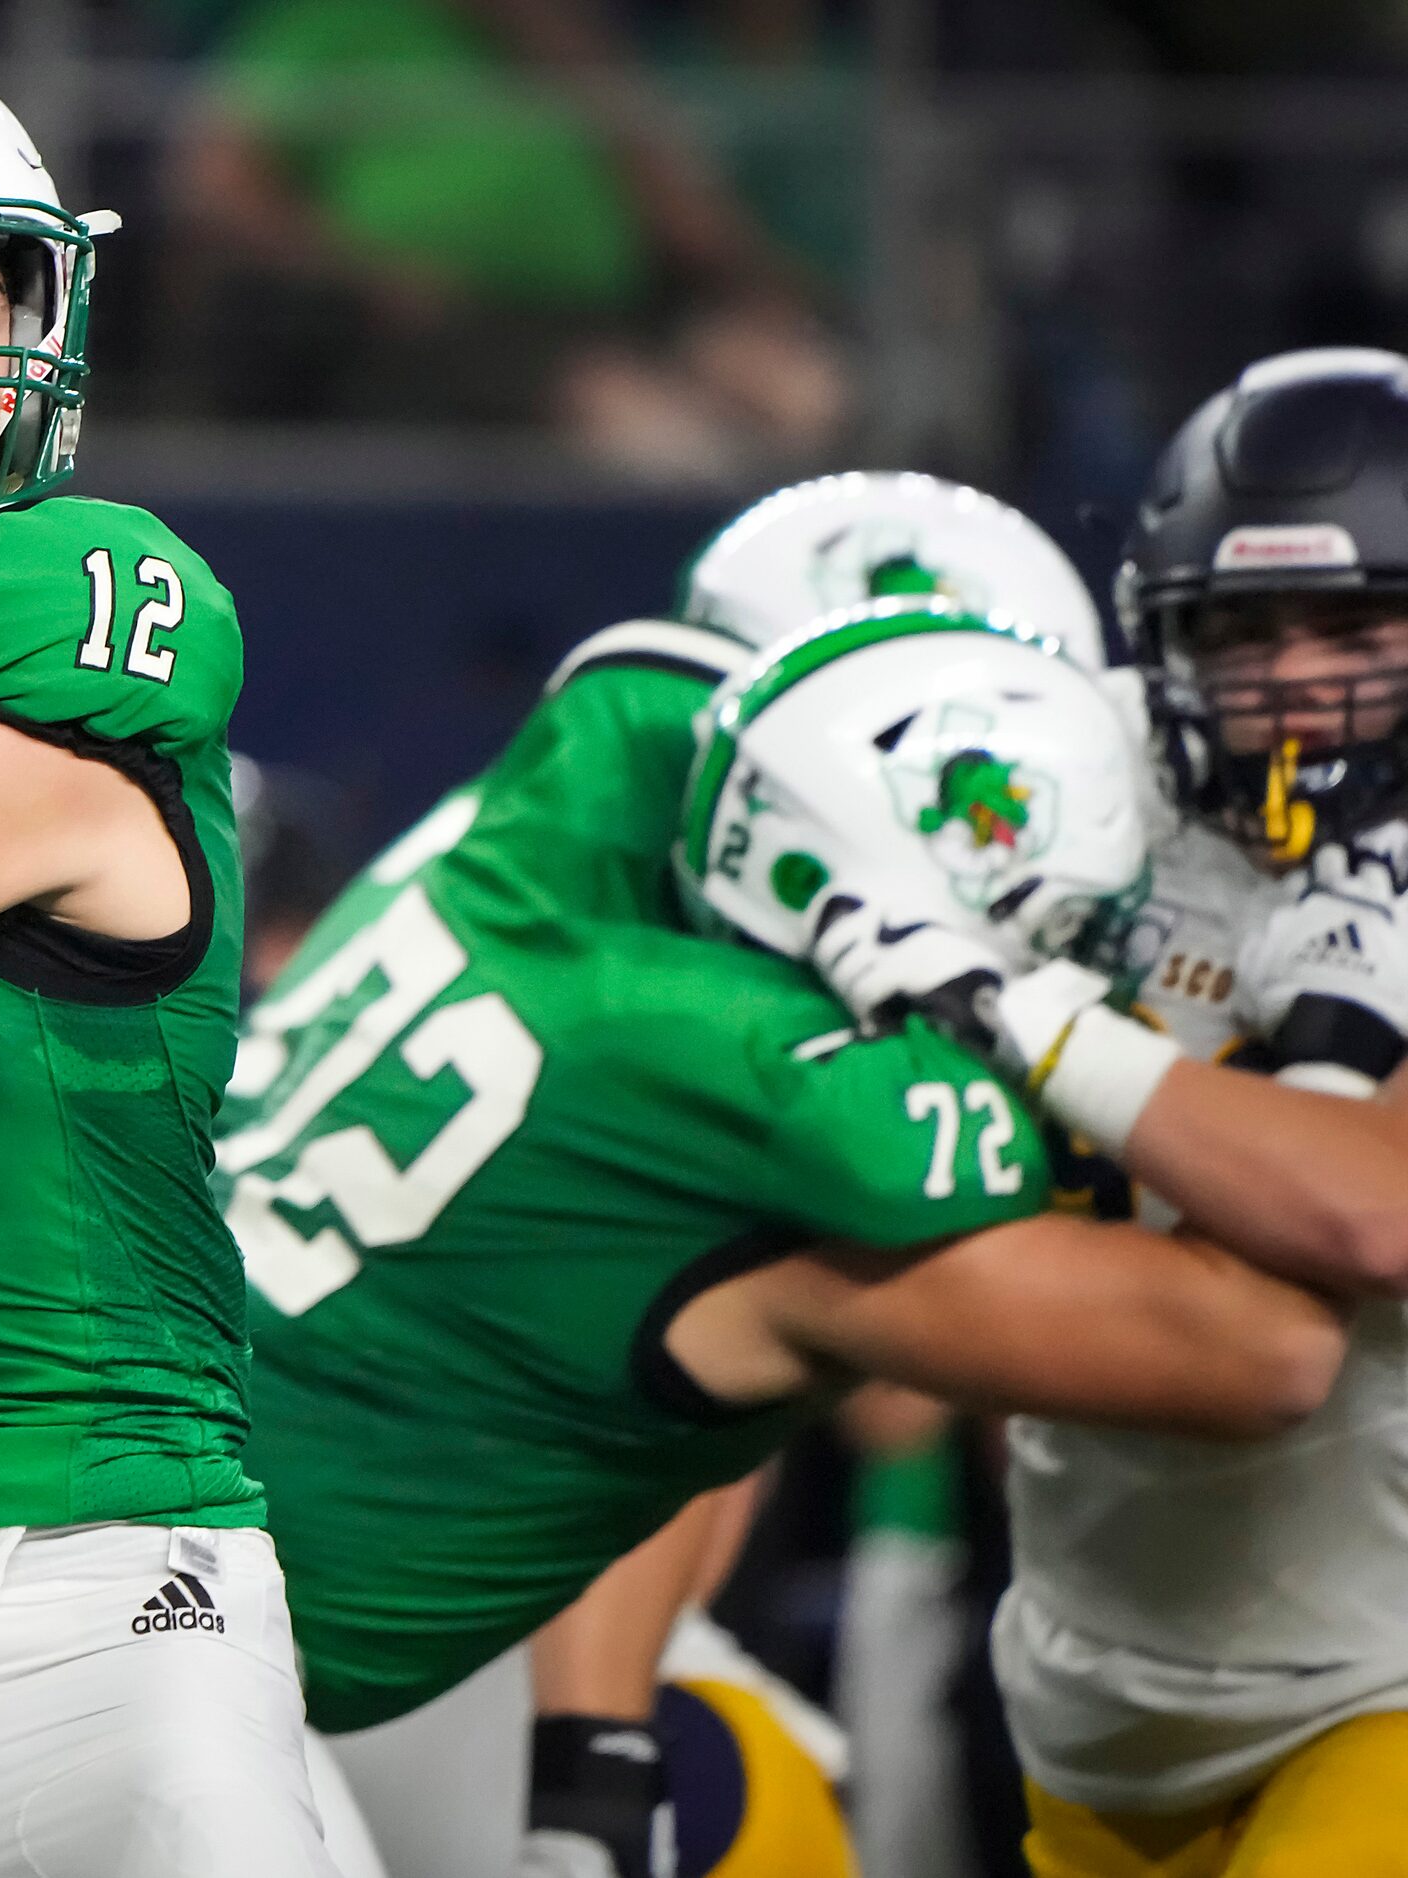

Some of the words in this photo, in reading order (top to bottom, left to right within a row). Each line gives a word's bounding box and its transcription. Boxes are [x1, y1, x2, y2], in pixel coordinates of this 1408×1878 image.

[74, 547, 185, 687] 12
[904, 1078, 1024, 1200] 72
[132, 1607, 225, 1635] adidas
